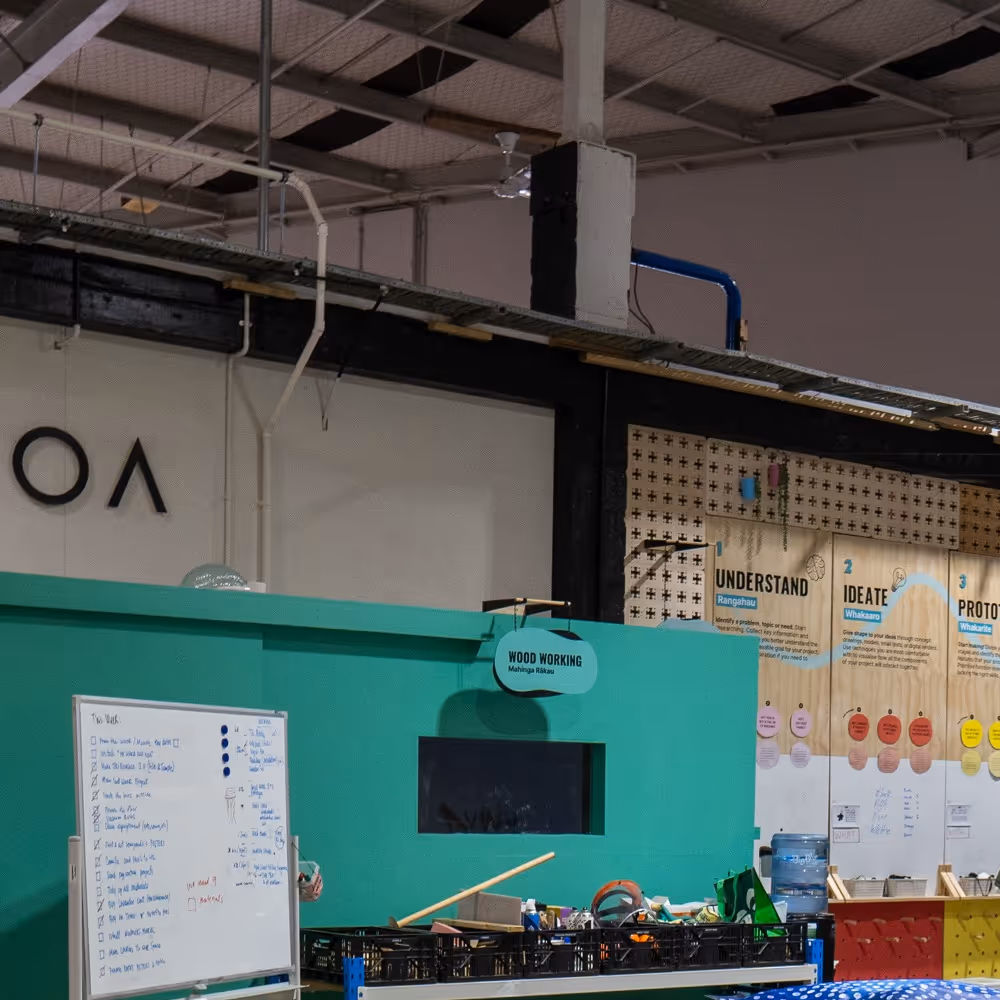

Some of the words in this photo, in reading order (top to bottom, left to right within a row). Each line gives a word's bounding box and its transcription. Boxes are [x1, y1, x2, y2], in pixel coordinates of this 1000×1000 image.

[843, 559, 853, 575] 2
[716, 568, 808, 597] UNDERSTAND
[959, 574, 967, 589] 3
[717, 595, 756, 608] Rangahau
[843, 584, 889, 607] IDEATE
[845, 609, 880, 621] Whakaaro
[773, 630, 799, 638] information
[508, 650, 537, 665] WOOD
[539, 652, 583, 668] WORKING
[508, 665, 535, 675] Mahinga
